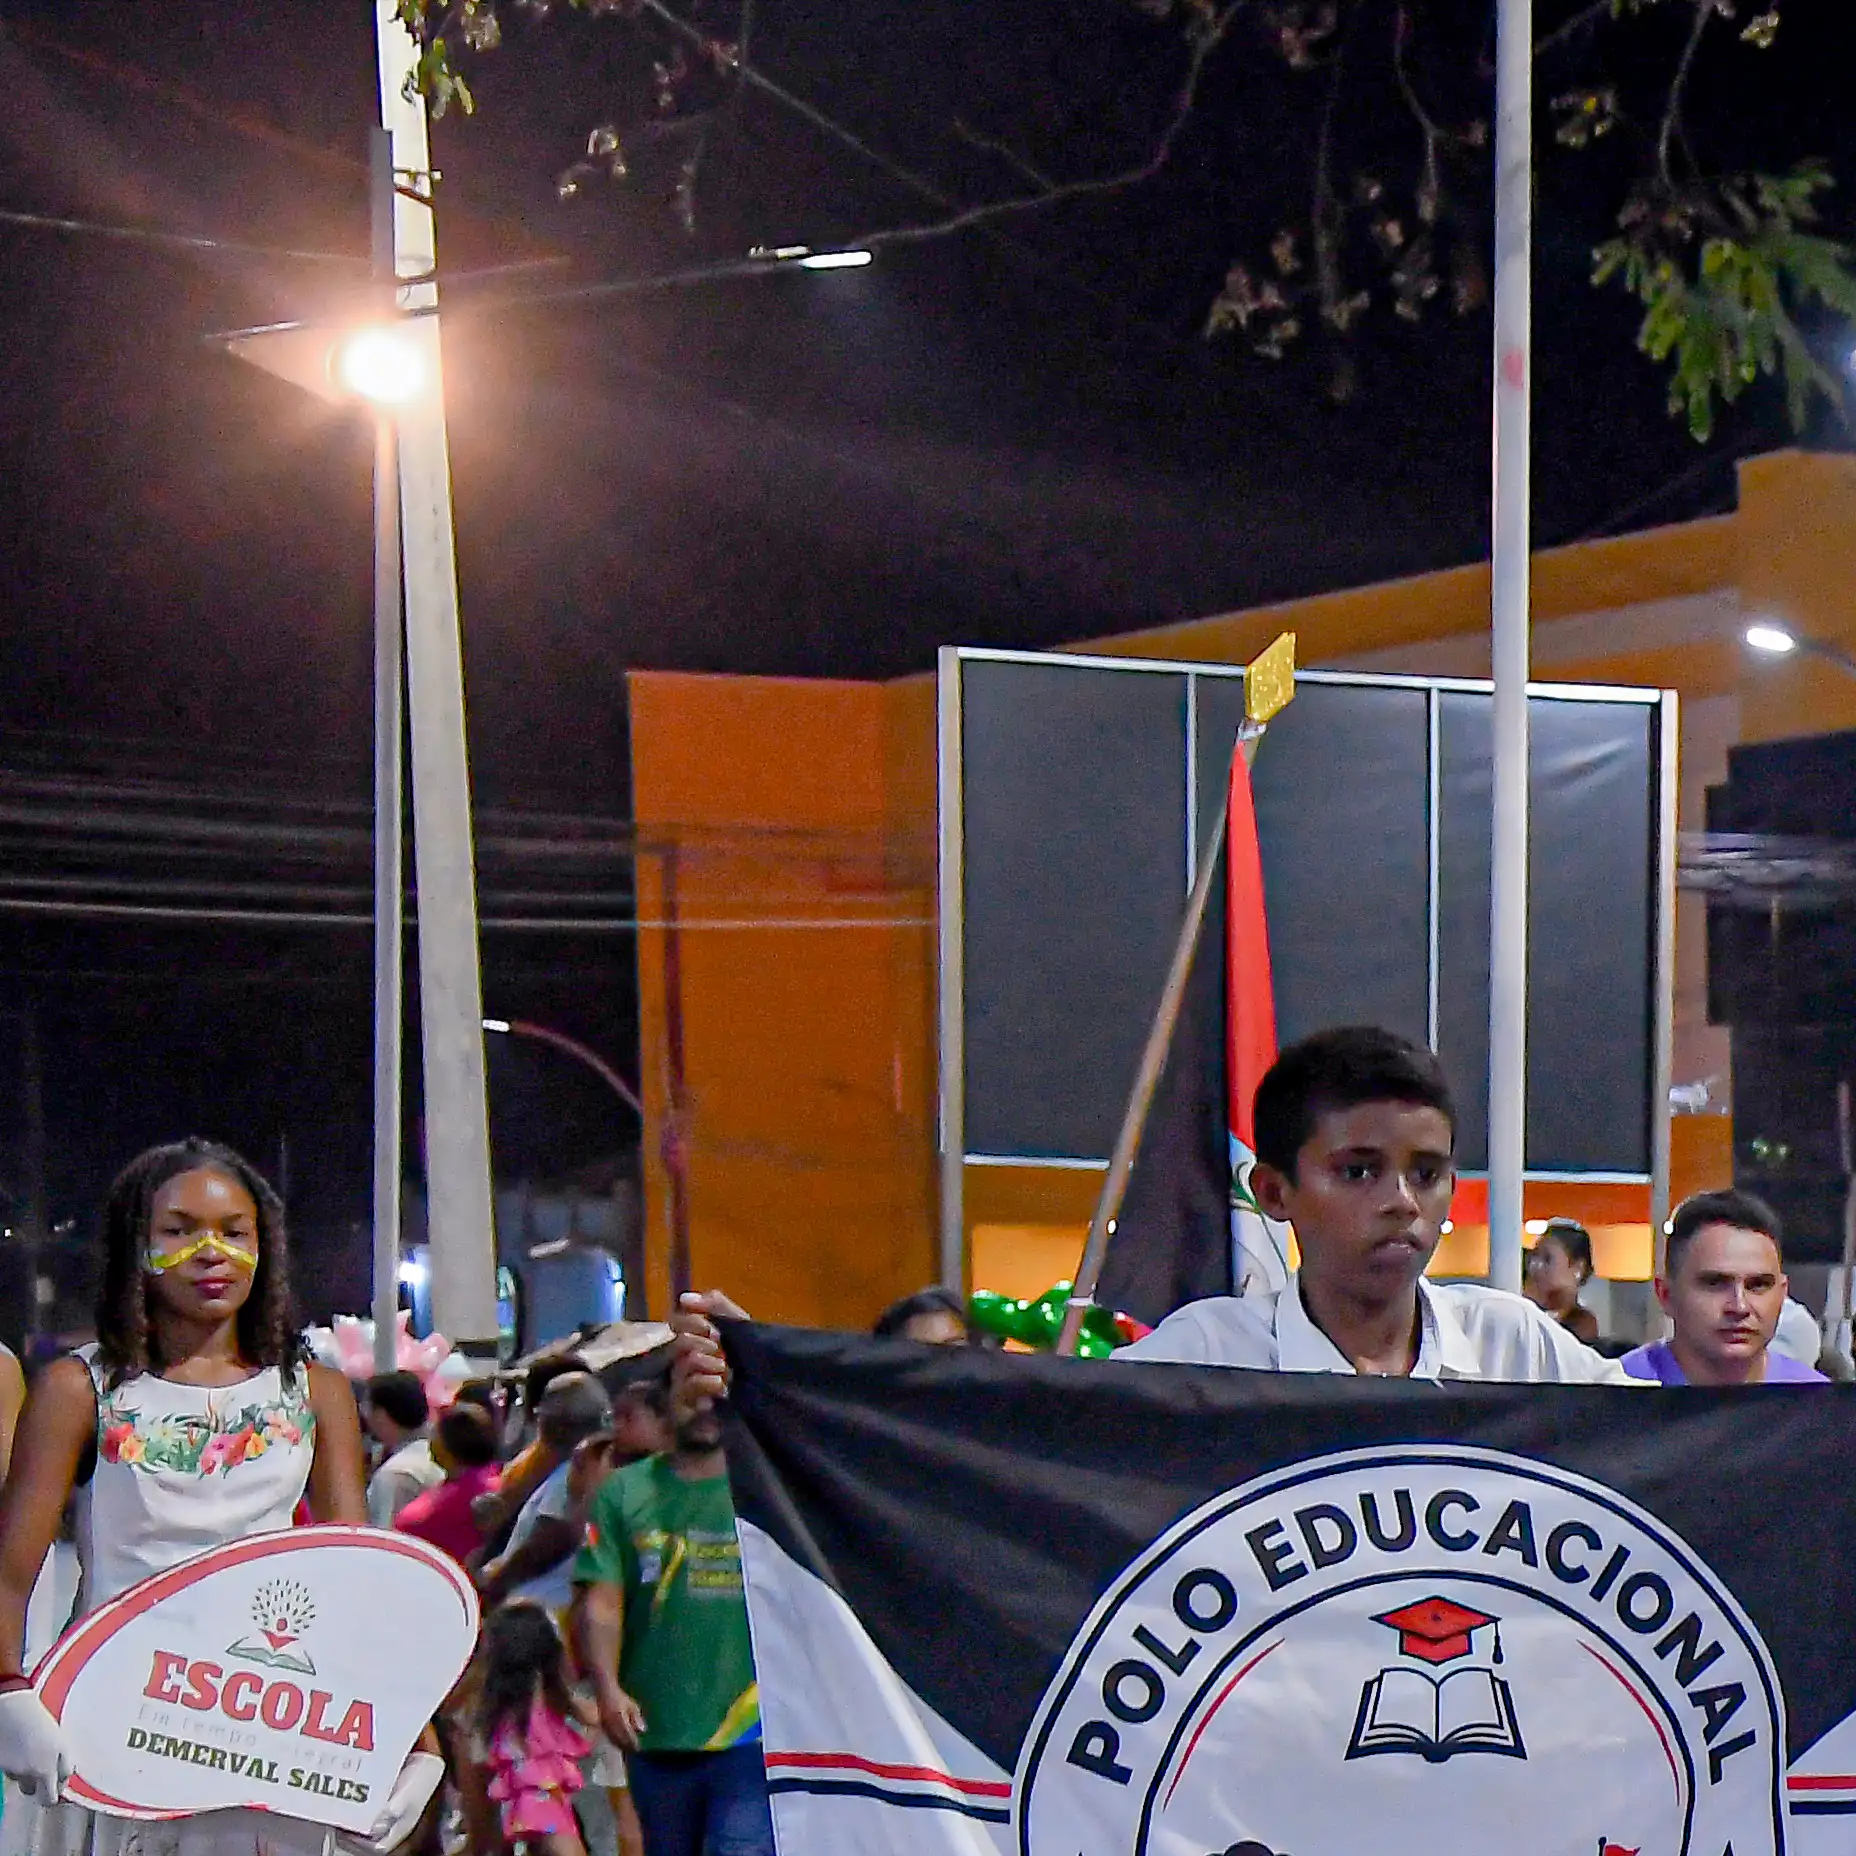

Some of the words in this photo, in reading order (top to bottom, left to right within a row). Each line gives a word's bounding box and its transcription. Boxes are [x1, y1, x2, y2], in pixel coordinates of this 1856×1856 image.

[1065, 1567, 1238, 1786] POLO
[1244, 1488, 1757, 1786] EDUCACIONAL
[143, 1649, 374, 1752] ESCOLA
[126, 1726, 280, 1785] DEMERVAL
[286, 1766, 370, 1803] SALES
